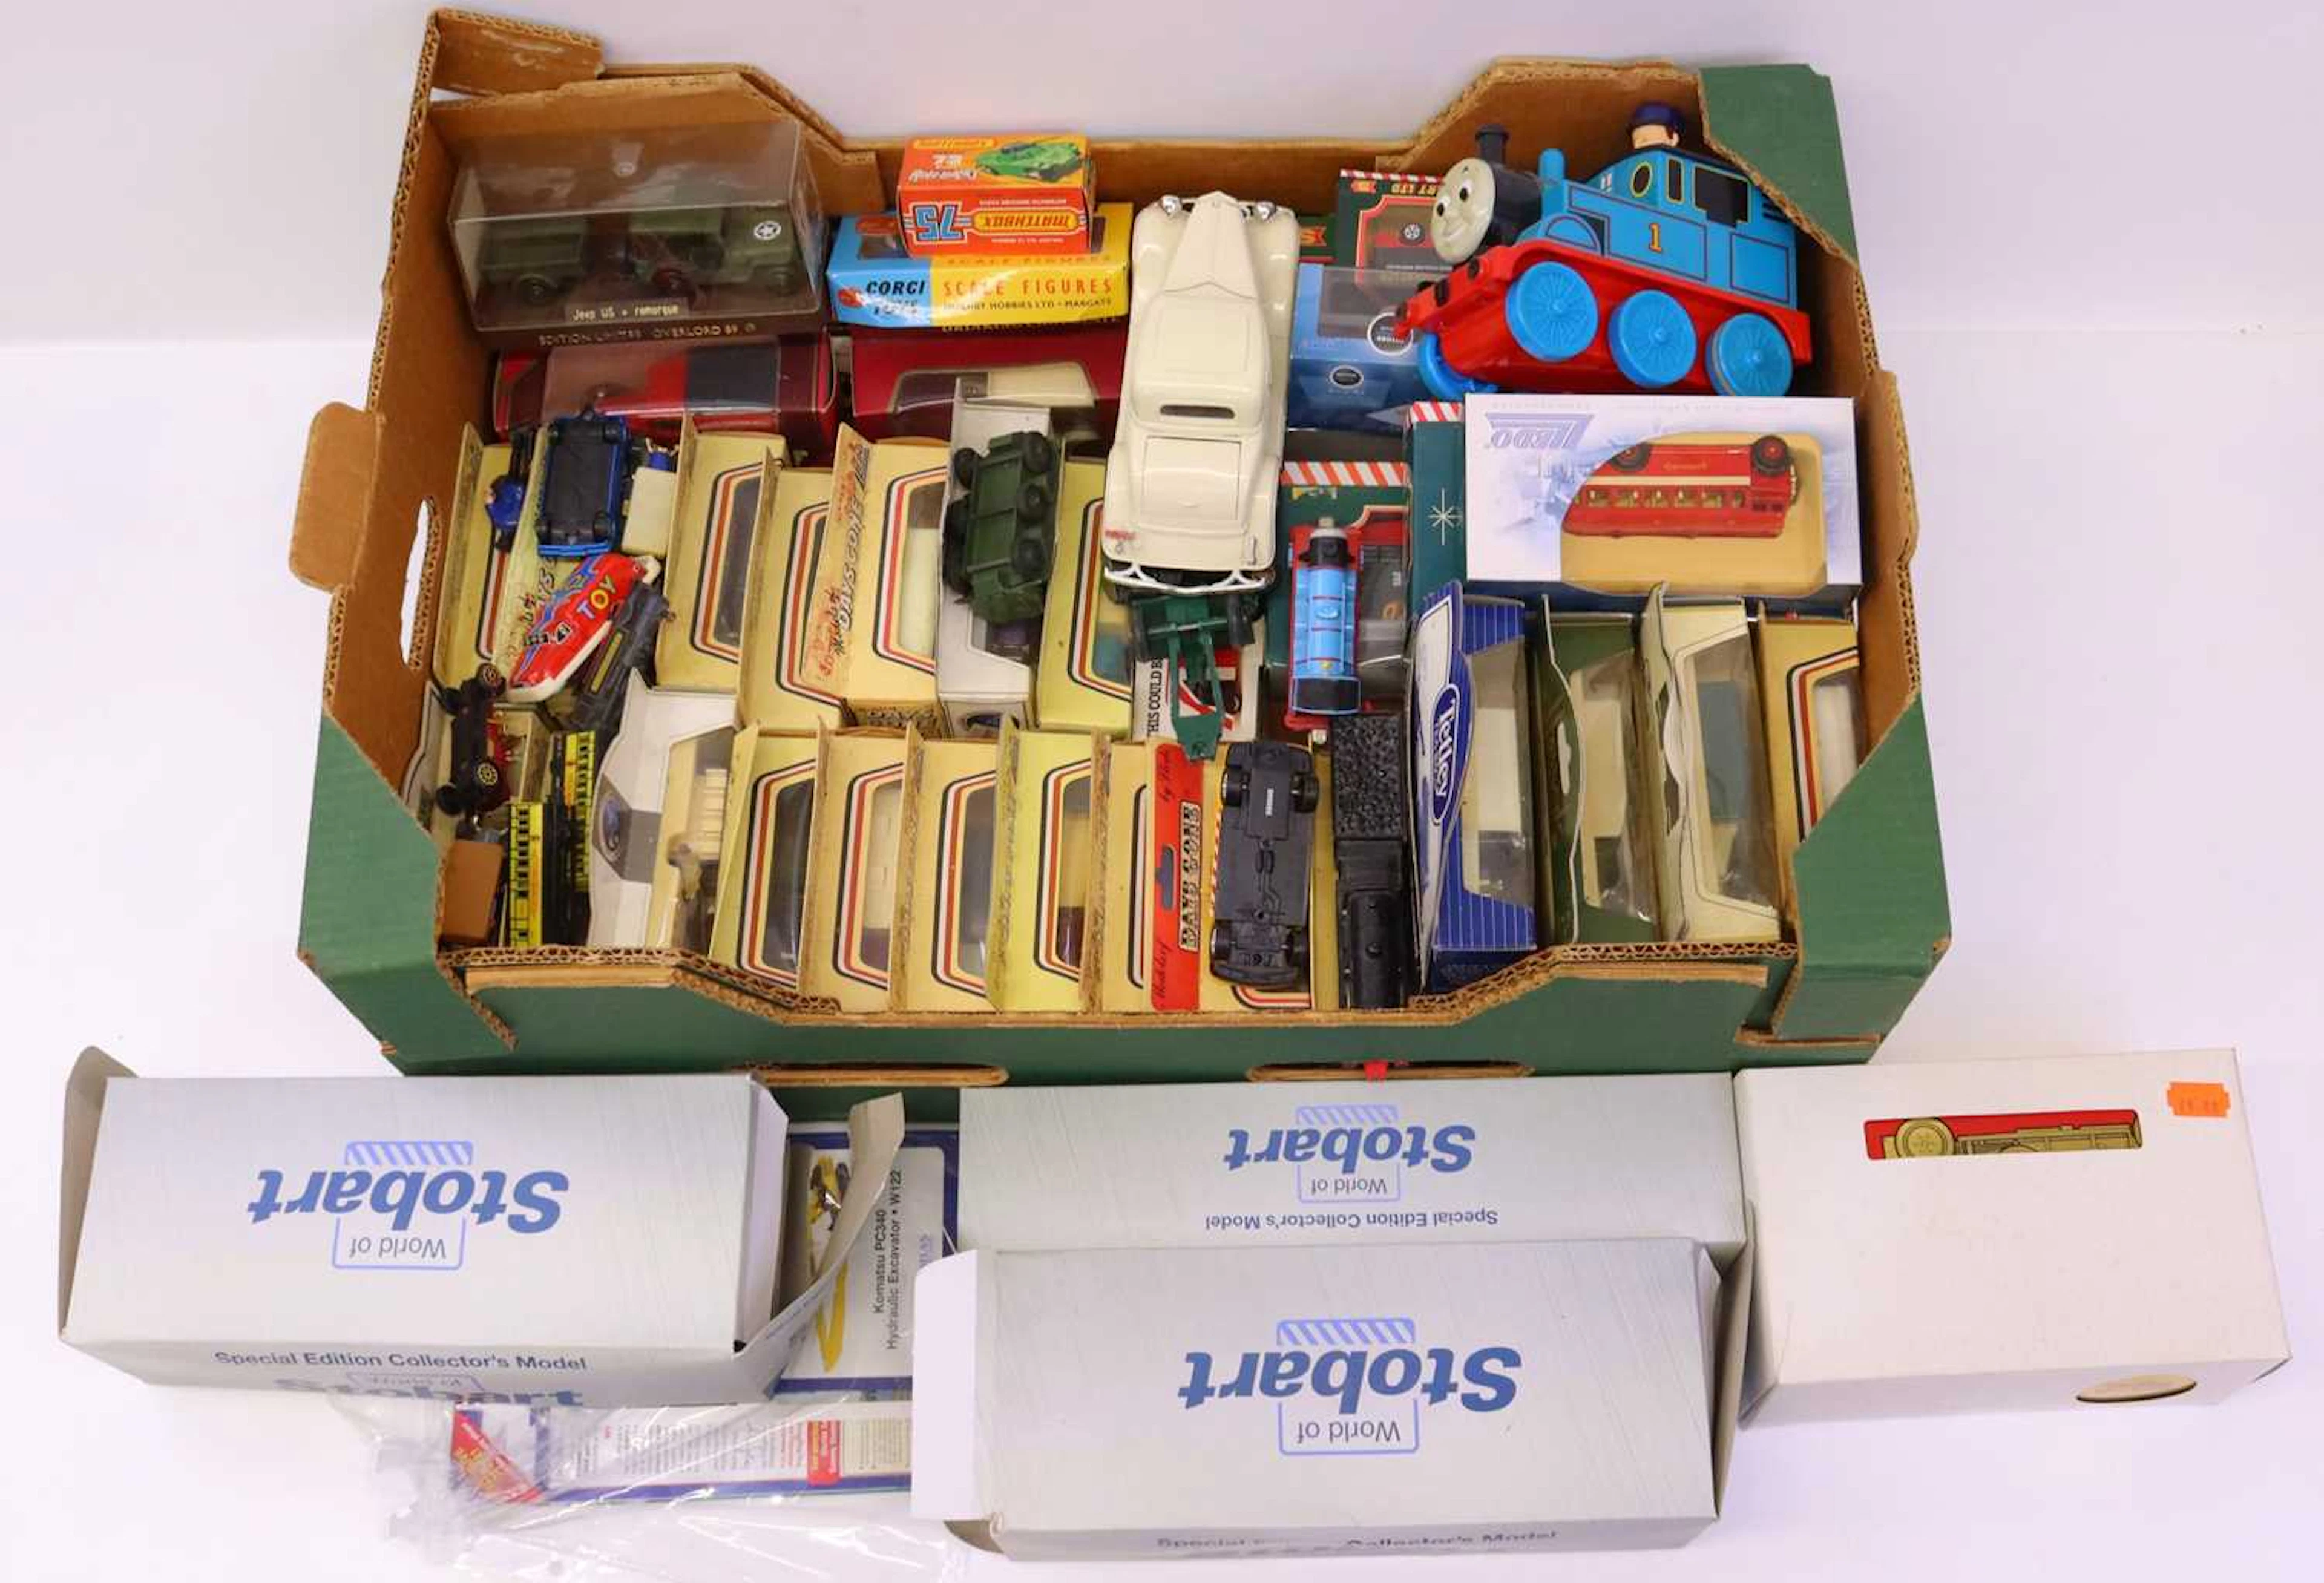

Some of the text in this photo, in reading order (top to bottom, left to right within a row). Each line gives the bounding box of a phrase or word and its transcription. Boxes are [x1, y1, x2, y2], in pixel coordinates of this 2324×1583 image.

[914, 203, 966, 240] 75
[1647, 222, 1662, 252] 1
[866, 280, 925, 295] CORGI
[1022, 278, 1113, 295] FIGURES
[576, 575, 617, 620] TOY
[1149, 671, 1162, 710] COULD
[1223, 1124, 1477, 1174] Stobart
[246, 1168, 570, 1234] Stobart
[1311, 1177, 1388, 1195] World of
[1205, 1210, 1498, 1231] Special Edition Collector's Model
[348, 1237, 447, 1259] World of
[873, 1209, 888, 1314] Komatsu PC340
[886, 1169, 902, 1350] Hydraulic Excavator W122
[214, 1350, 587, 1372] Special Edition Collector's Model
[1178, 1346, 1522, 1414] Stobart
[1296, 1420, 1402, 1444] World of
